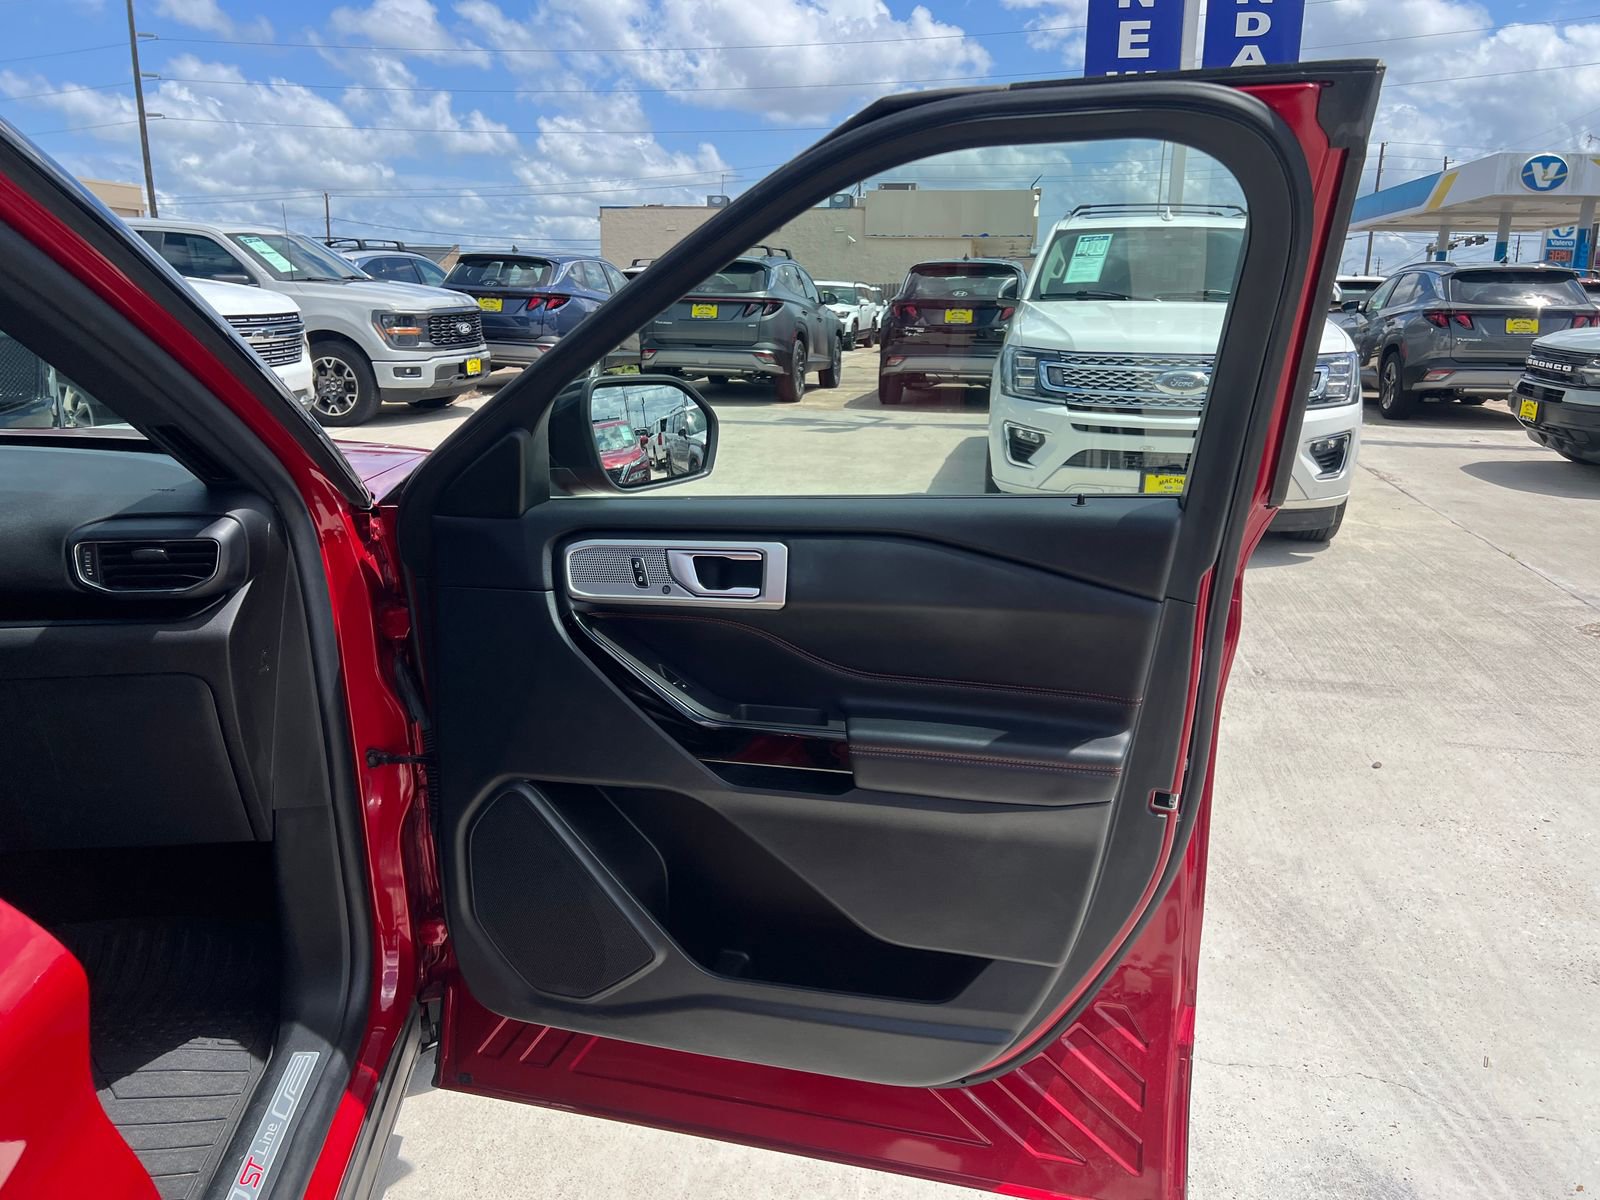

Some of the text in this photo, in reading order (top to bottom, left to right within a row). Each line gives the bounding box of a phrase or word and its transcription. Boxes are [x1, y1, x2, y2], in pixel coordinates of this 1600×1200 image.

[1230, 0, 1273, 67] DA
[1550, 239, 1573, 247] Valero
[1527, 358, 1572, 372] BRONCO
[1170, 378, 1195, 387] Ford
[239, 1122, 278, 1188] ST Line
